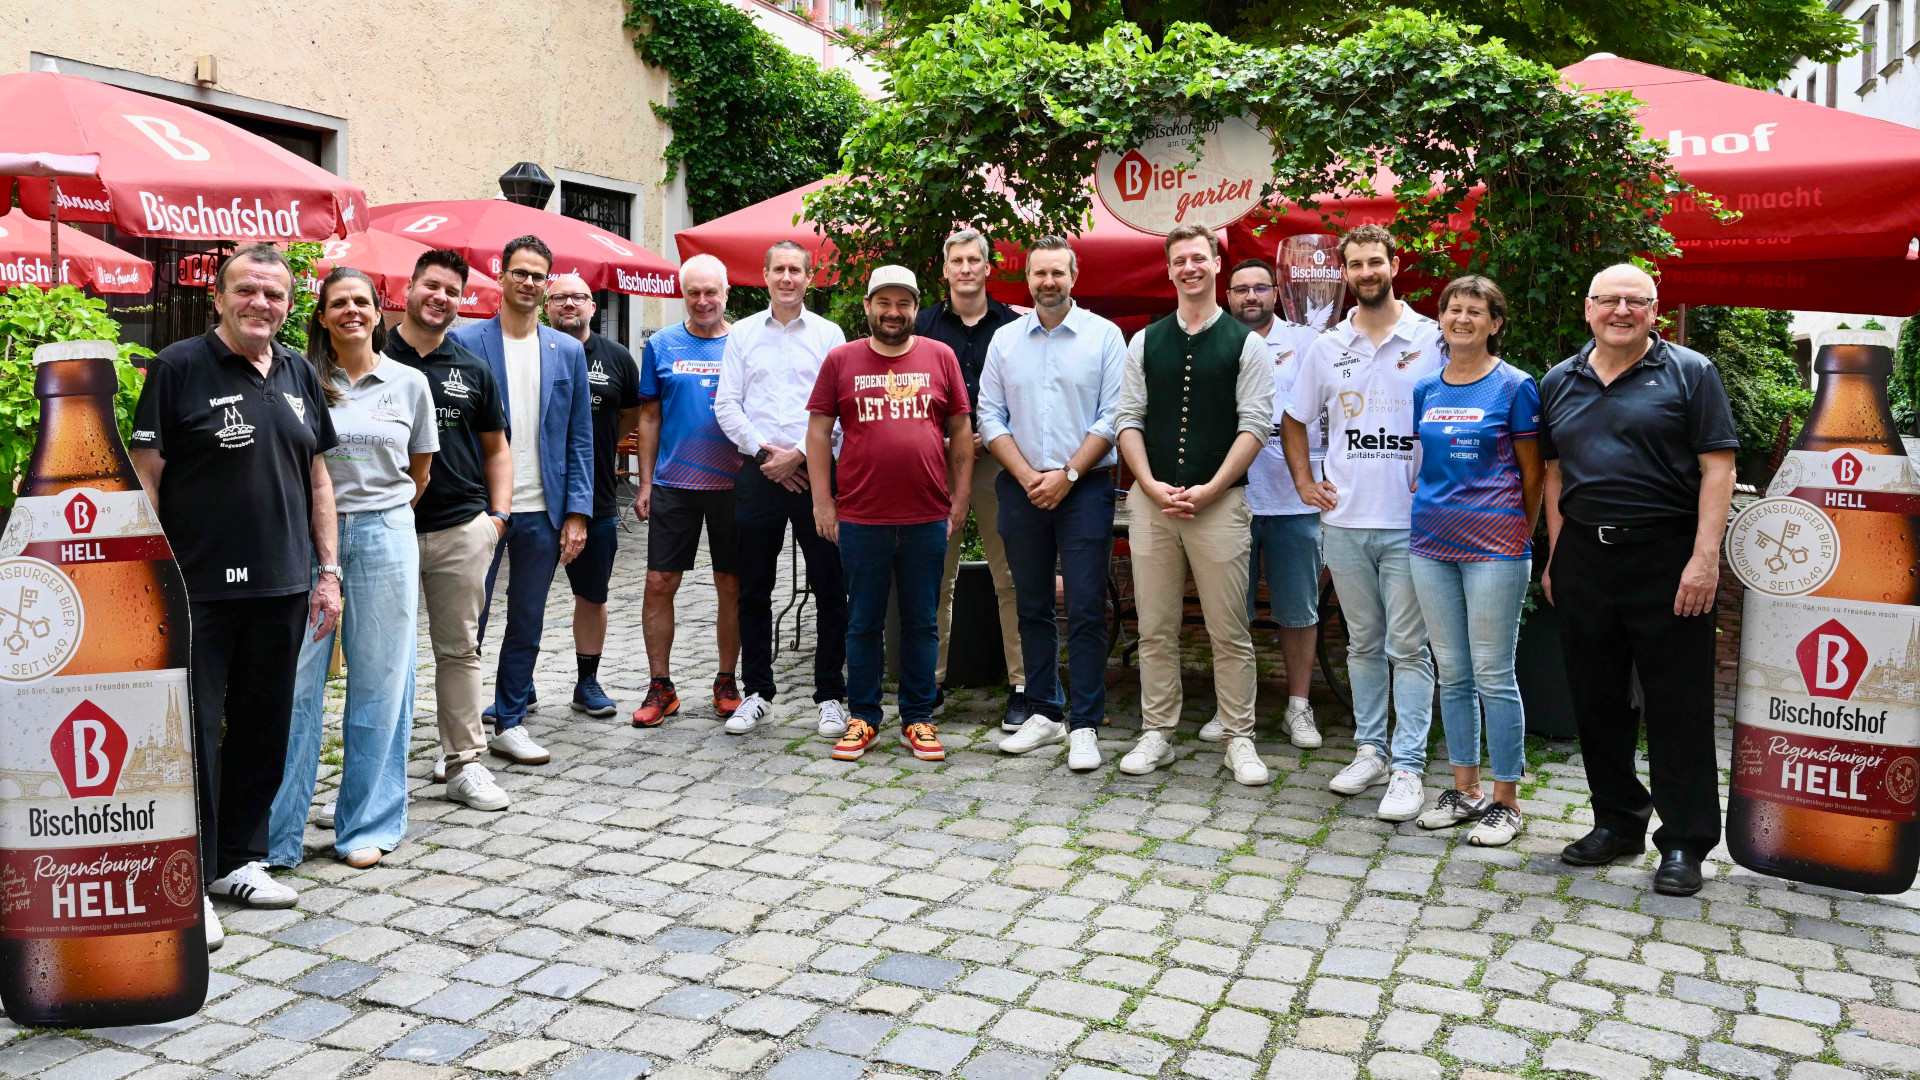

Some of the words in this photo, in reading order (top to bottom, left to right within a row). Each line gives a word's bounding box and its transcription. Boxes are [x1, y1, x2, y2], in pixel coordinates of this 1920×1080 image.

[1167, 140, 1179, 148] am
[1175, 178, 1253, 223] garten
[1738, 186, 1823, 210] macht
[139, 191, 300, 236] Bischofshof
[617, 268, 675, 294] Bischofshof
[1291, 264, 1342, 279] Bischofshof
[854, 374, 890, 392] PHOENIX
[891, 372, 931, 388] COUNTRY
[209, 394, 244, 408] Kempa
[902, 394, 932, 419] FLY
[1345, 427, 1415, 452] Reiss
[1840, 458, 1854, 482] B
[1825, 492, 1866, 508] HELL
[74, 502, 90, 530] B
[1739, 504, 1824, 533] REGENSBURGER
[61, 542, 106, 562] HELL
[1735, 536, 1760, 582] ORIGINAL
[1819, 533, 1832, 559] BIER
[226, 567, 248, 582] DM
[1770, 580, 1794, 591] SEIT
[1798, 566, 1823, 588] 1649
[60, 596, 75, 627] BIER
[1844, 608, 1876, 616] Freunden
[12, 663, 40, 676] SEIT
[42, 638, 68, 667] 1649
[1816, 634, 1850, 690] B
[96, 682, 129, 691] Freunden
[1769, 696, 1888, 734] Bischofshof
[72, 720, 110, 788] B
[1768, 736, 1884, 774] Regensburger
[1780, 760, 1868, 800] HELL
[29, 800, 156, 837] Bischofshof
[34, 852, 158, 888] Regensburger
[52, 879, 146, 918] HELL
[71, 924, 112, 932] Regensburger
